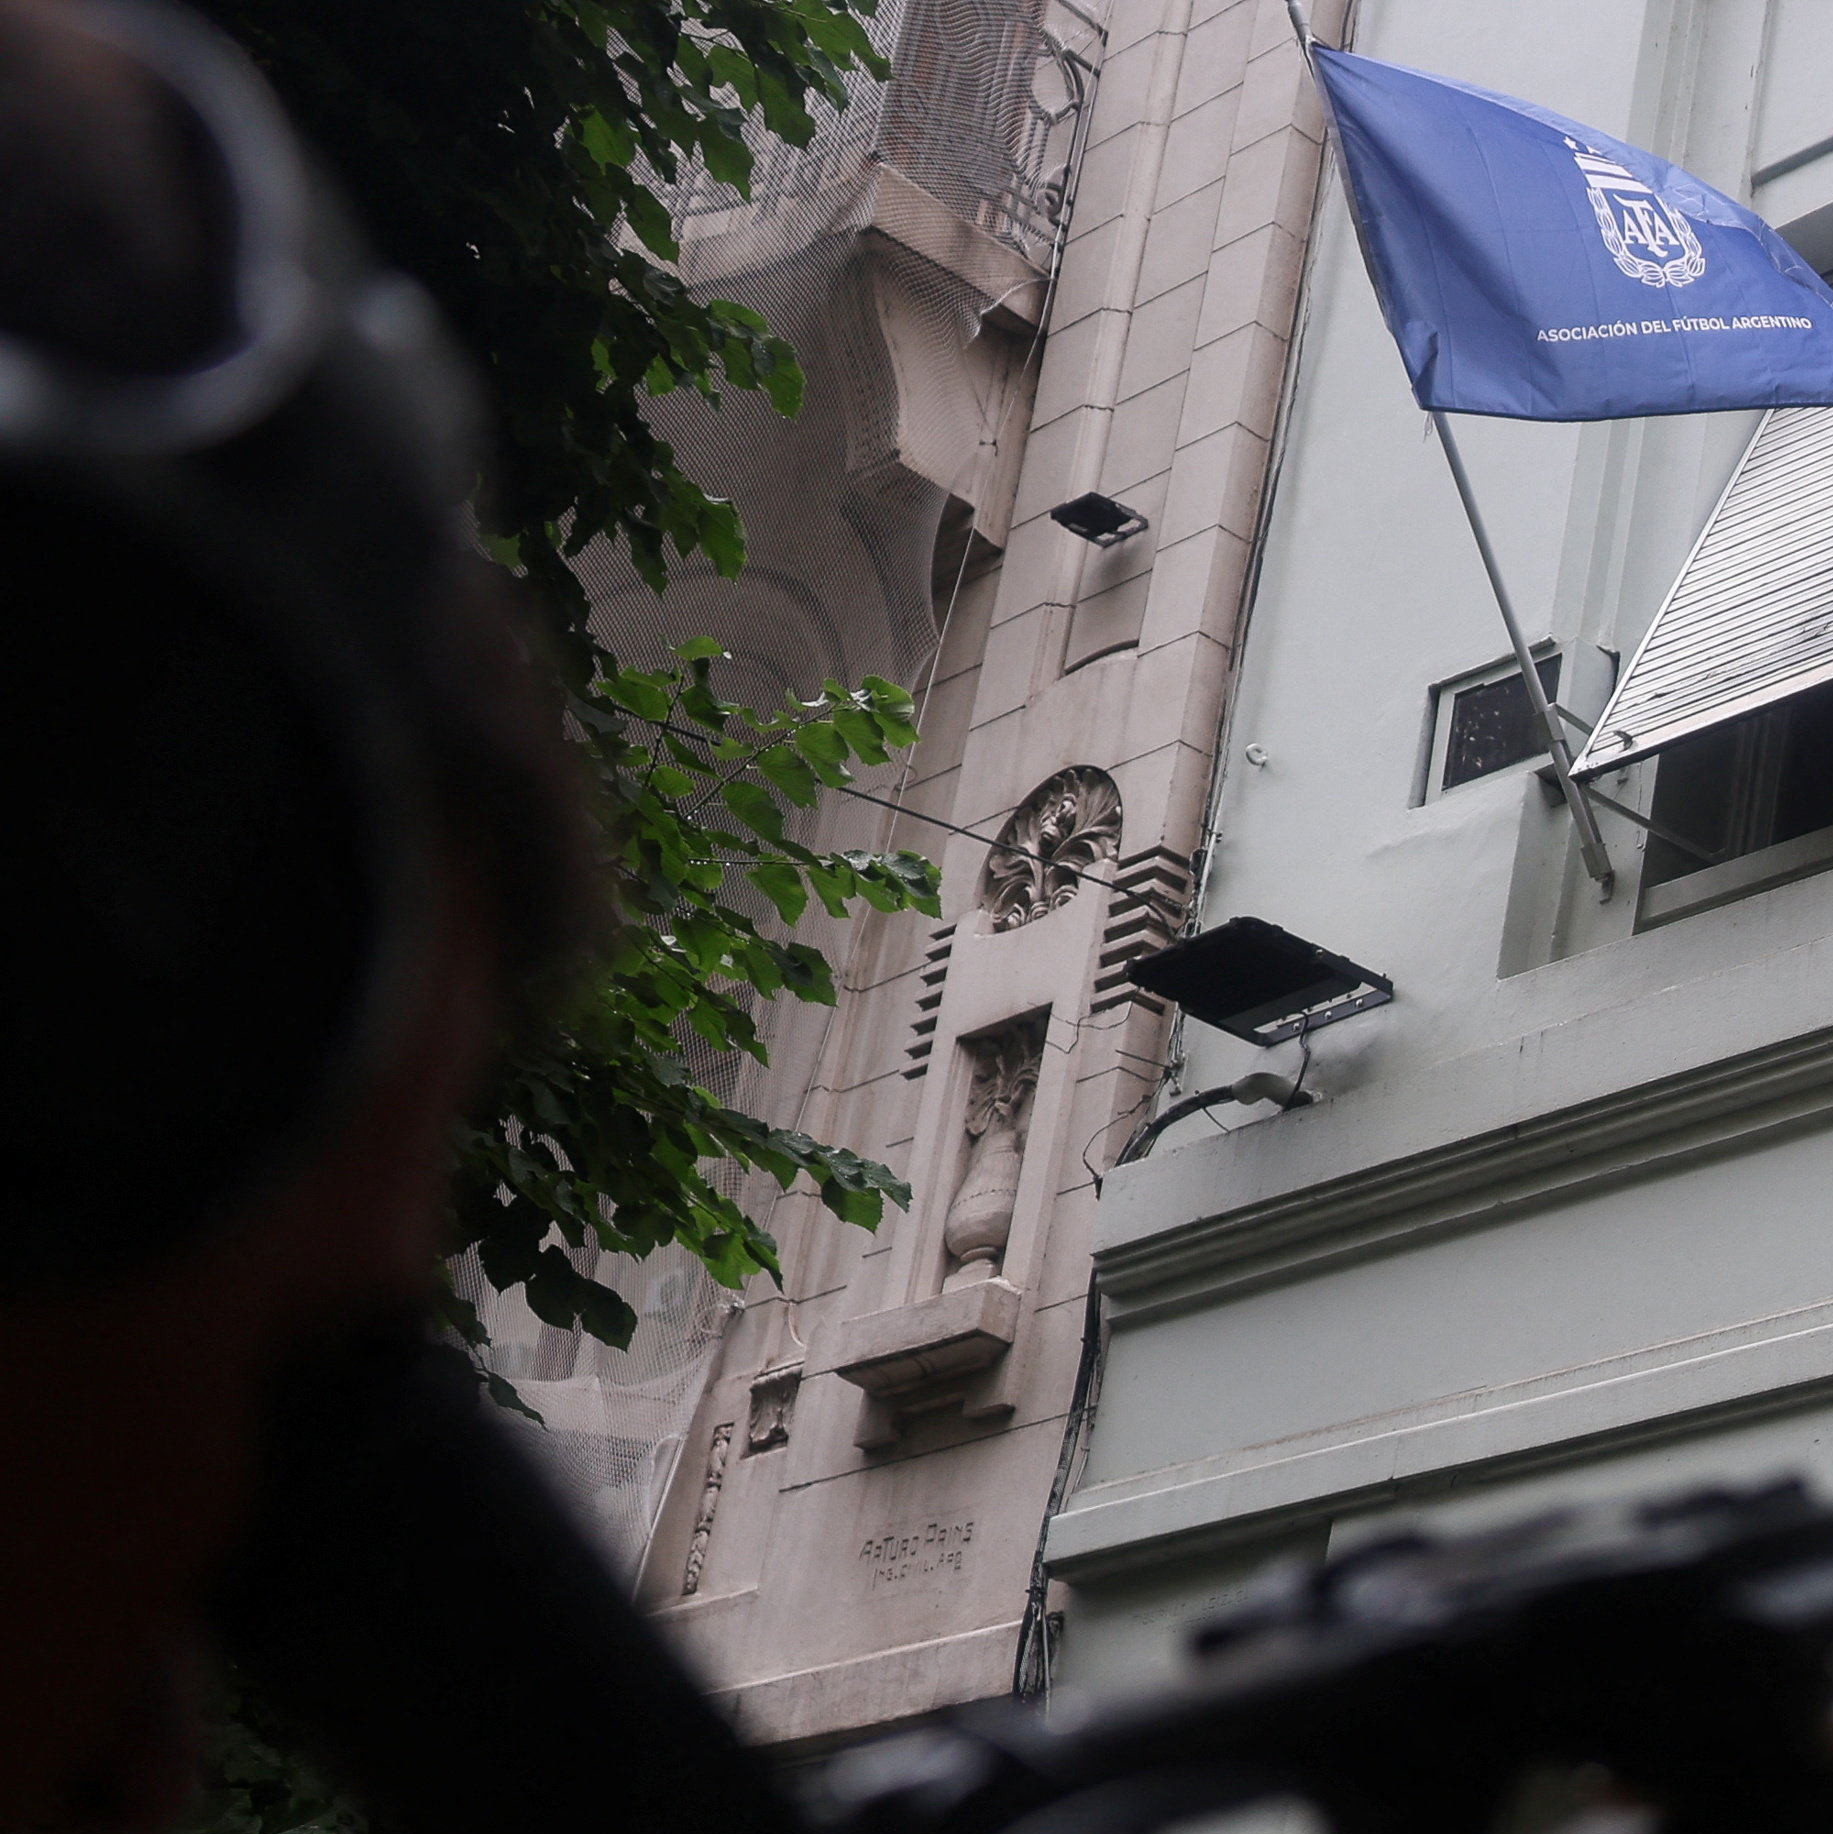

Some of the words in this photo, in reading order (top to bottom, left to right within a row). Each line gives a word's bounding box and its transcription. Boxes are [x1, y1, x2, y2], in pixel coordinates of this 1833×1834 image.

[1537, 319, 1638, 342] ASOCIACIÓN
[1642, 319, 1671, 334] DEL
[1673, 316, 1731, 332] FÚTBOL
[1732, 315, 1812, 330] ARGENTINO
